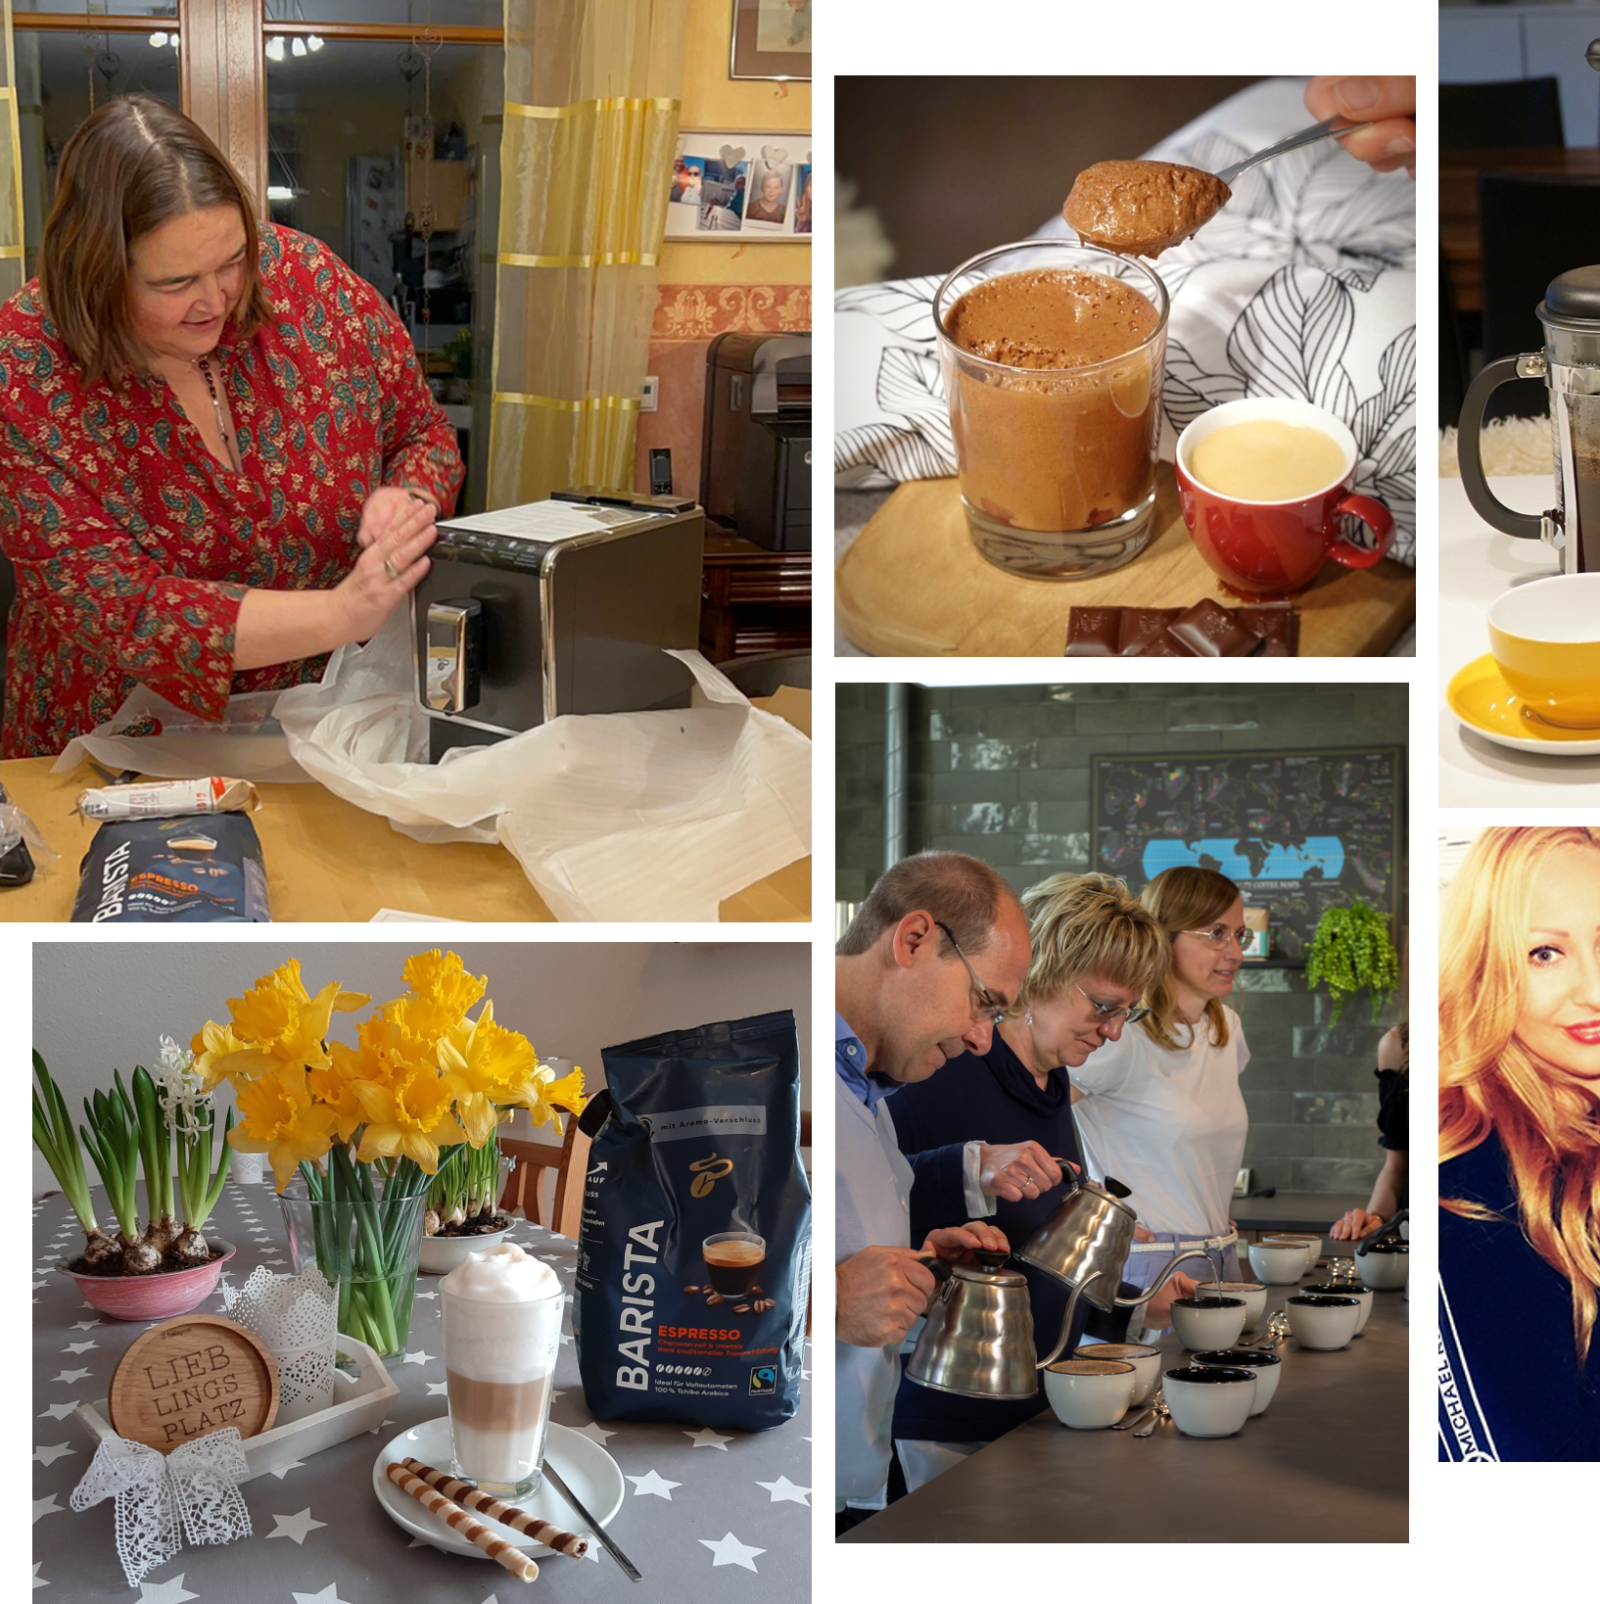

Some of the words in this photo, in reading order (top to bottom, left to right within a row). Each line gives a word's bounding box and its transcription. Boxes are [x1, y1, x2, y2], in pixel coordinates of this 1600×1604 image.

[92, 841, 131, 923] BARISTA
[130, 873, 199, 892] ESPRESSO
[661, 1123, 676, 1131] mit
[679, 1116, 762, 1128] Aroma-Verschluss
[587, 1176, 606, 1184] AUF
[616, 1219, 666, 1392] BARISTA
[658, 1325, 741, 1341] ESPRESSO
[658, 1339, 707, 1349] Charaktervoll
[677, 1348, 724, 1356] traditioneller
[143, 1345, 230, 1390] LIEB
[673, 1380, 684, 1388] für
[685, 1381, 738, 1389] Vollautomaten
[701, 1389, 729, 1397] Arabica
[152, 1372, 239, 1417] LINGS
[1438, 1358, 1477, 1455] MICHAEL
[162, 1398, 246, 1444] PLATZ
